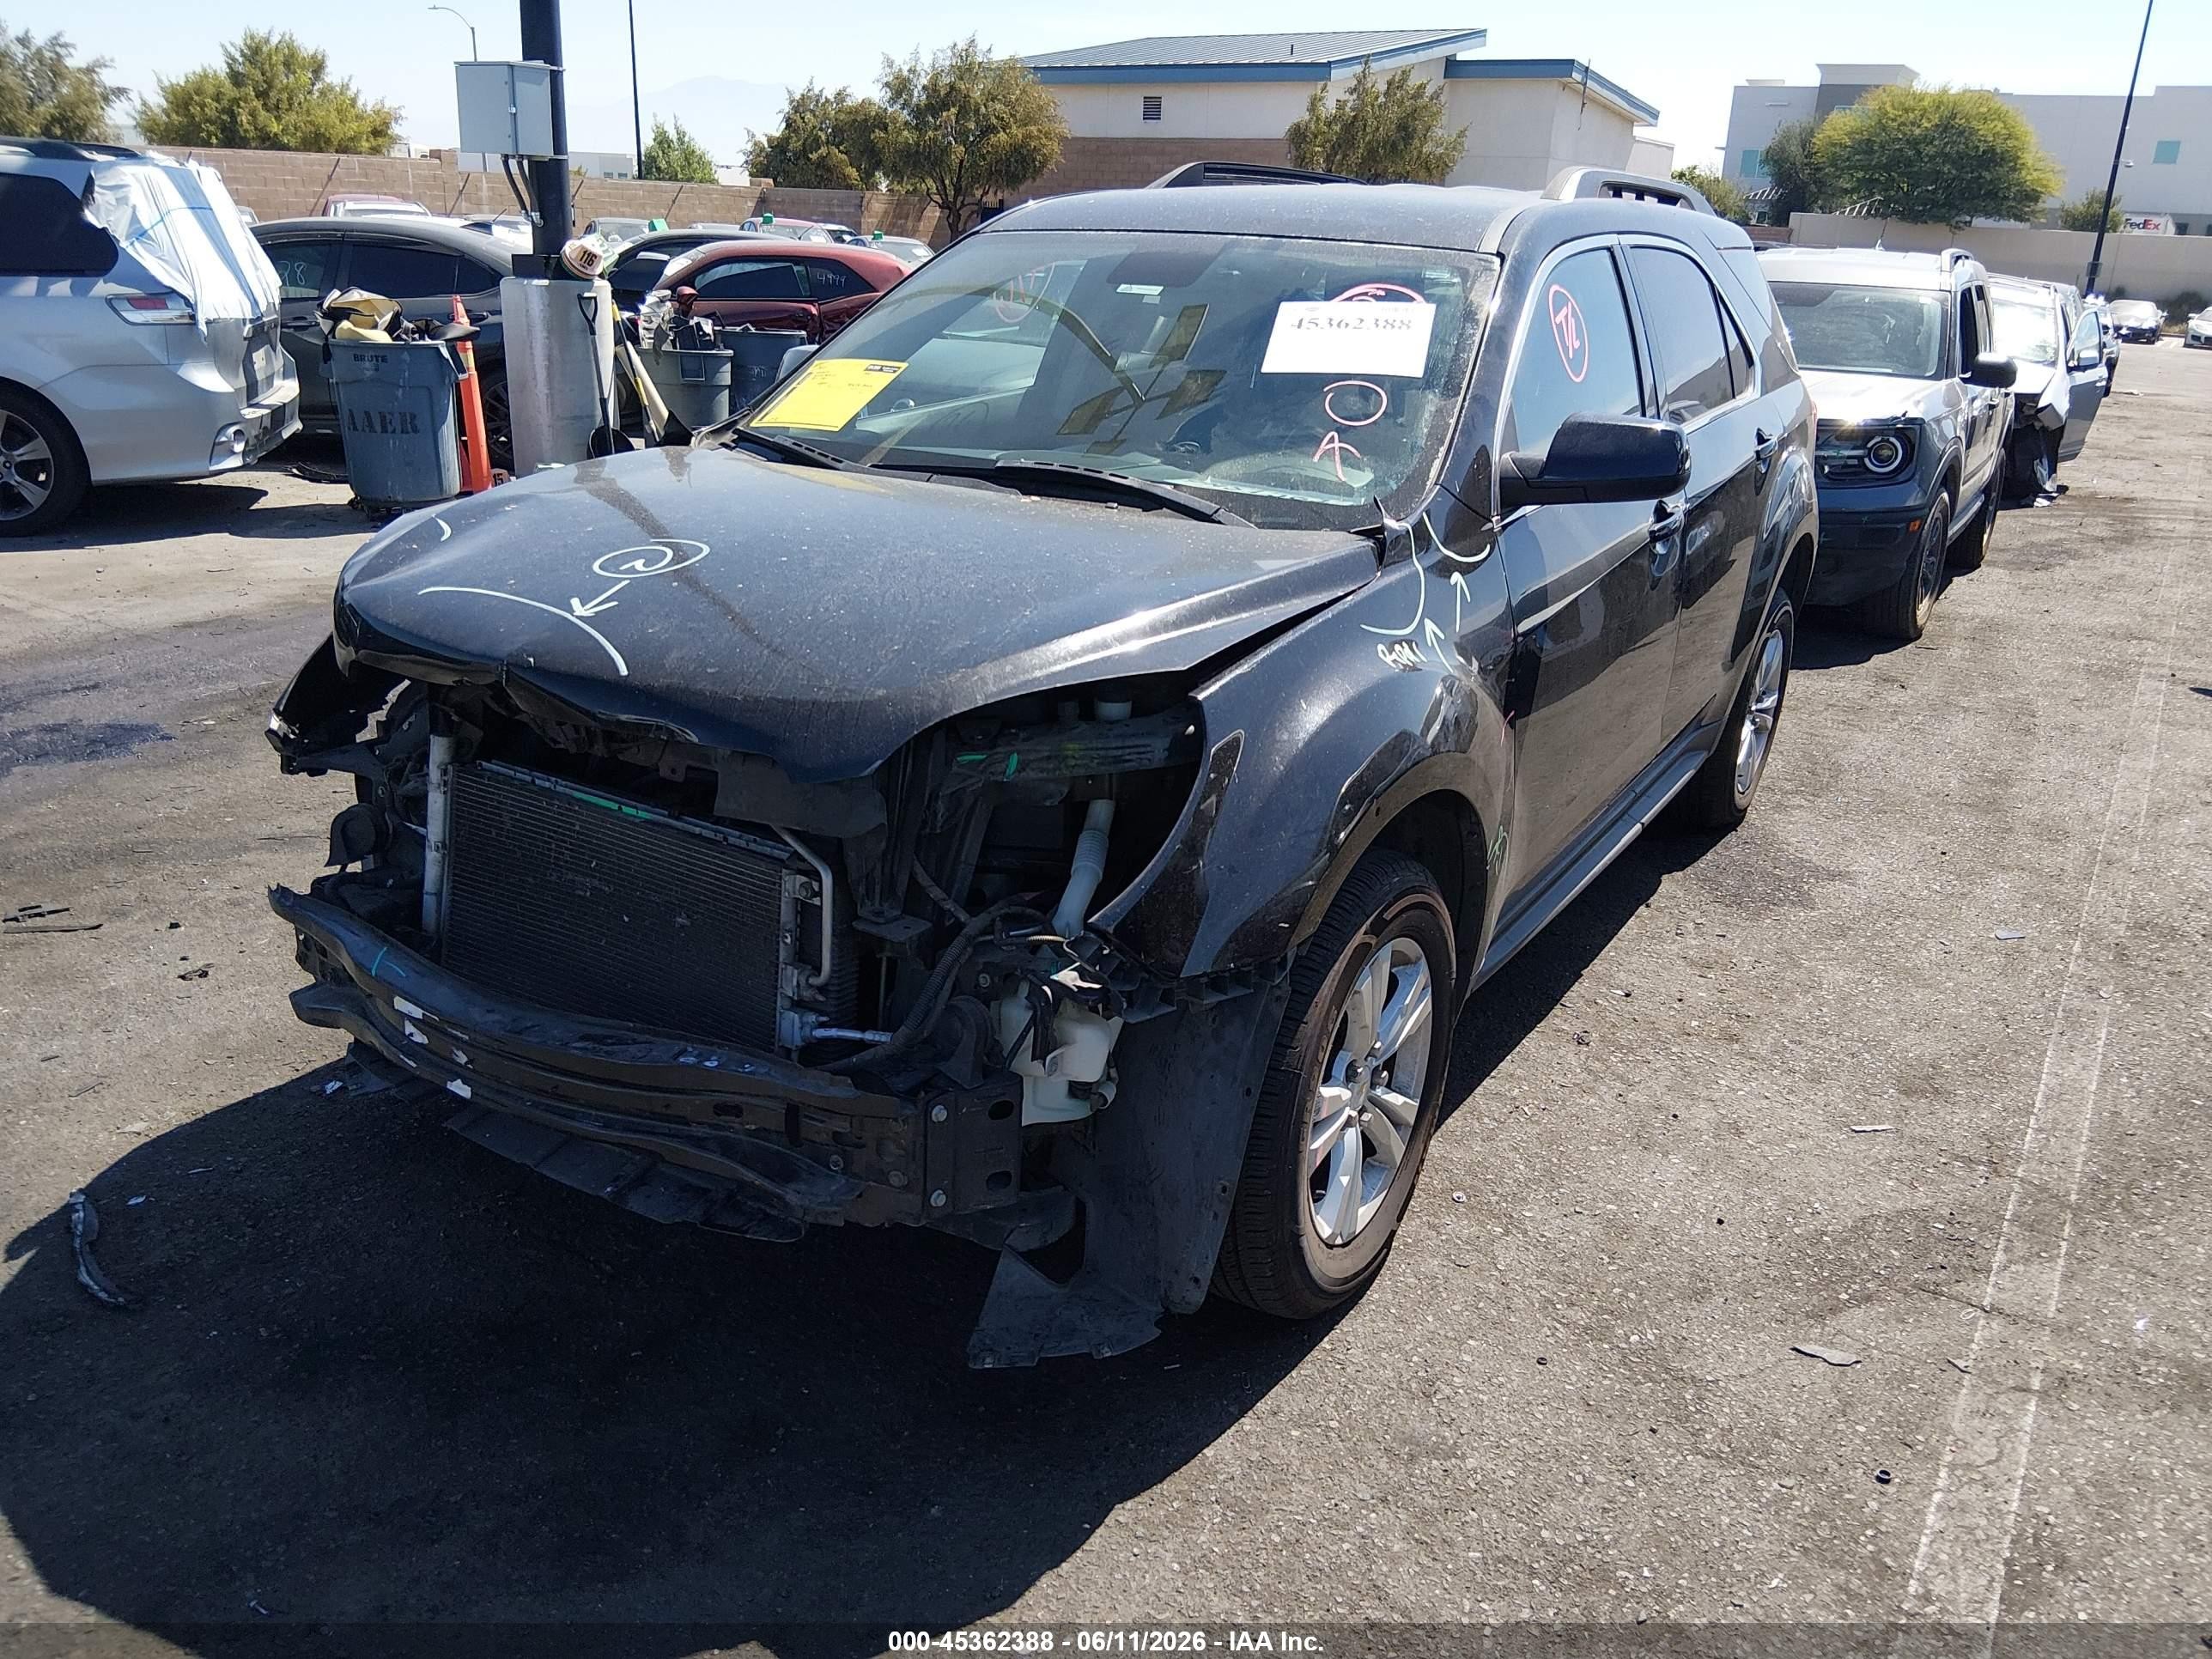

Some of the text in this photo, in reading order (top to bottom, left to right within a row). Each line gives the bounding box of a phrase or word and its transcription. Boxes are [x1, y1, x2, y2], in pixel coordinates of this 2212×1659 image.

[2124, 218, 2161, 230] FedEx
[580, 249, 598, 267] 116
[817, 271, 847, 288] 4999
[1291, 318, 1413, 331] 45362388
[353, 353, 388, 364] BRUTE
[347, 408, 420, 434] AAER
